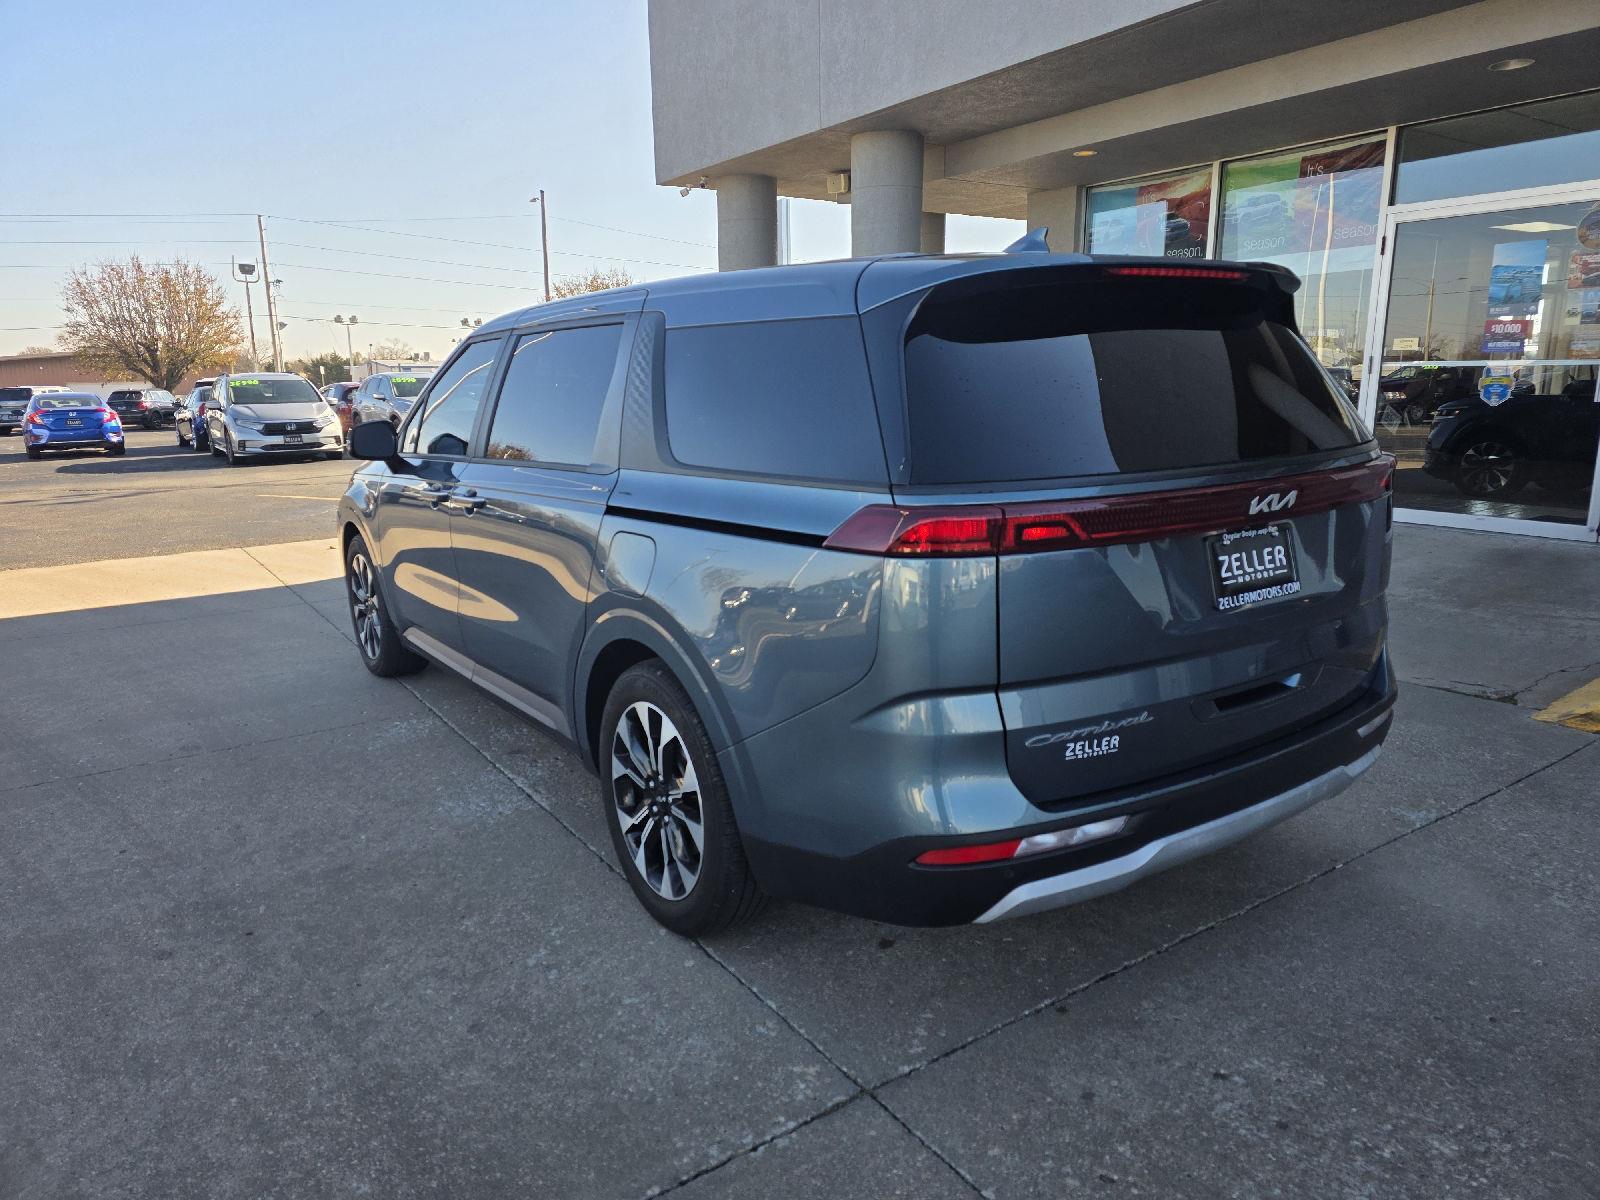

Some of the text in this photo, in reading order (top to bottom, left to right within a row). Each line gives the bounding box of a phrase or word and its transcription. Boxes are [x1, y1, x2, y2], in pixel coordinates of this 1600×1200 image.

[1307, 162, 1324, 177] It's
[1248, 490, 1298, 515] KIA
[1218, 545, 1286, 578] ZELLER
[1238, 569, 1274, 583] MOTORS
[1218, 581, 1301, 610] ZELLERMOTORS.COM
[1065, 735, 1120, 757] ZELLER
